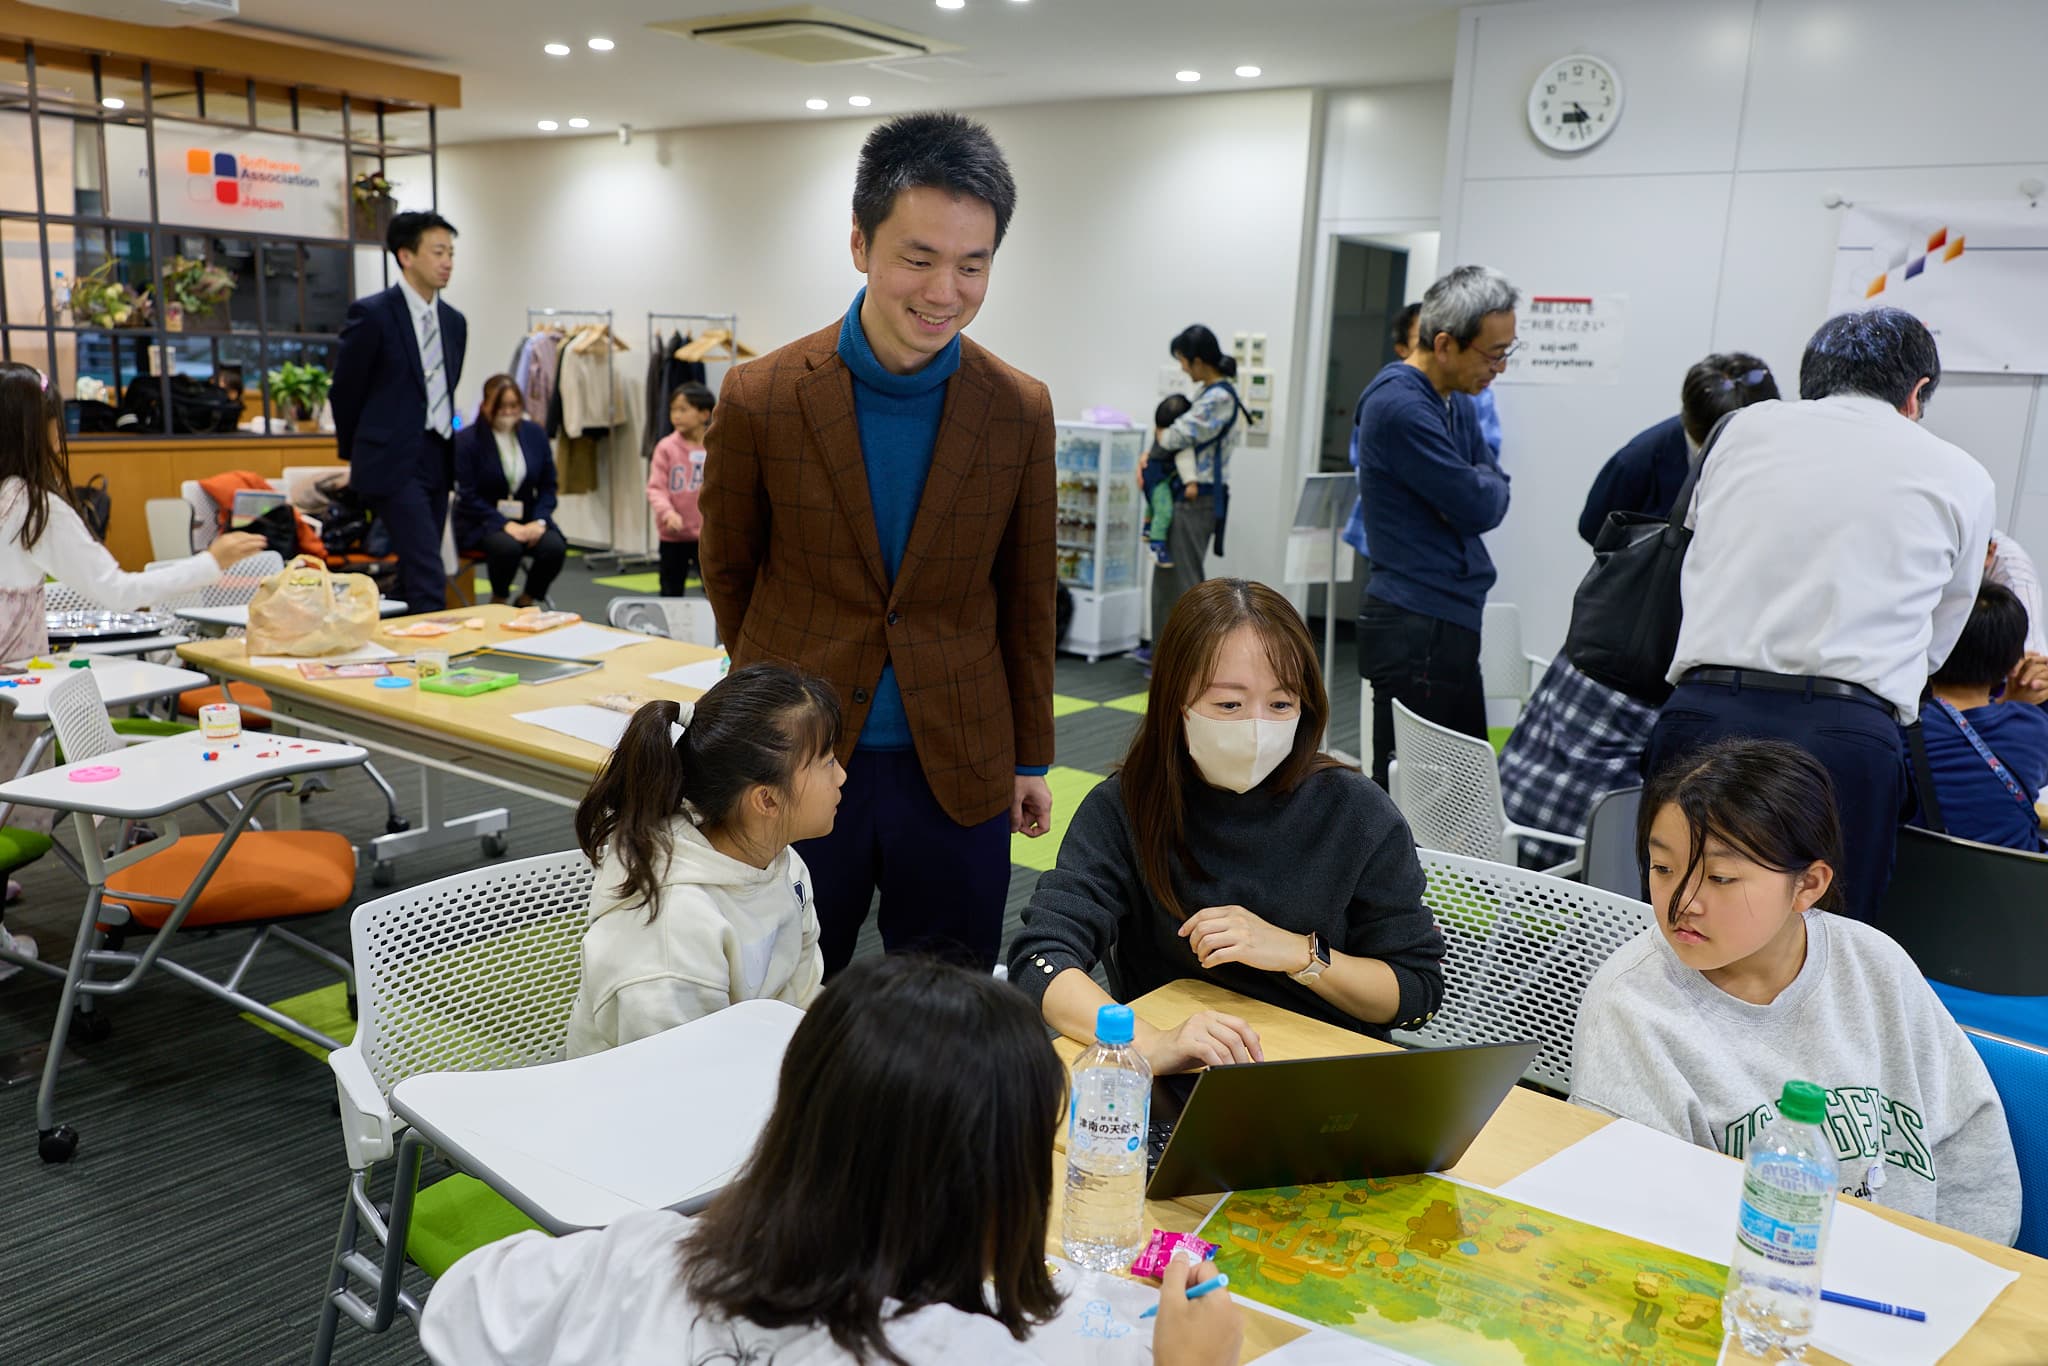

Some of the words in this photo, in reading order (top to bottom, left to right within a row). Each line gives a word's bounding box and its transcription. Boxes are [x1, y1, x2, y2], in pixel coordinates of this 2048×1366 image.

[239, 153, 302, 173] Software
[240, 168, 320, 188] Association
[241, 195, 285, 211] Japan
[1519, 319, 1607, 332] ご利用ください
[1531, 358, 1595, 370] everywhere
[1080, 1117, 1141, 1135] 津南の天然水
